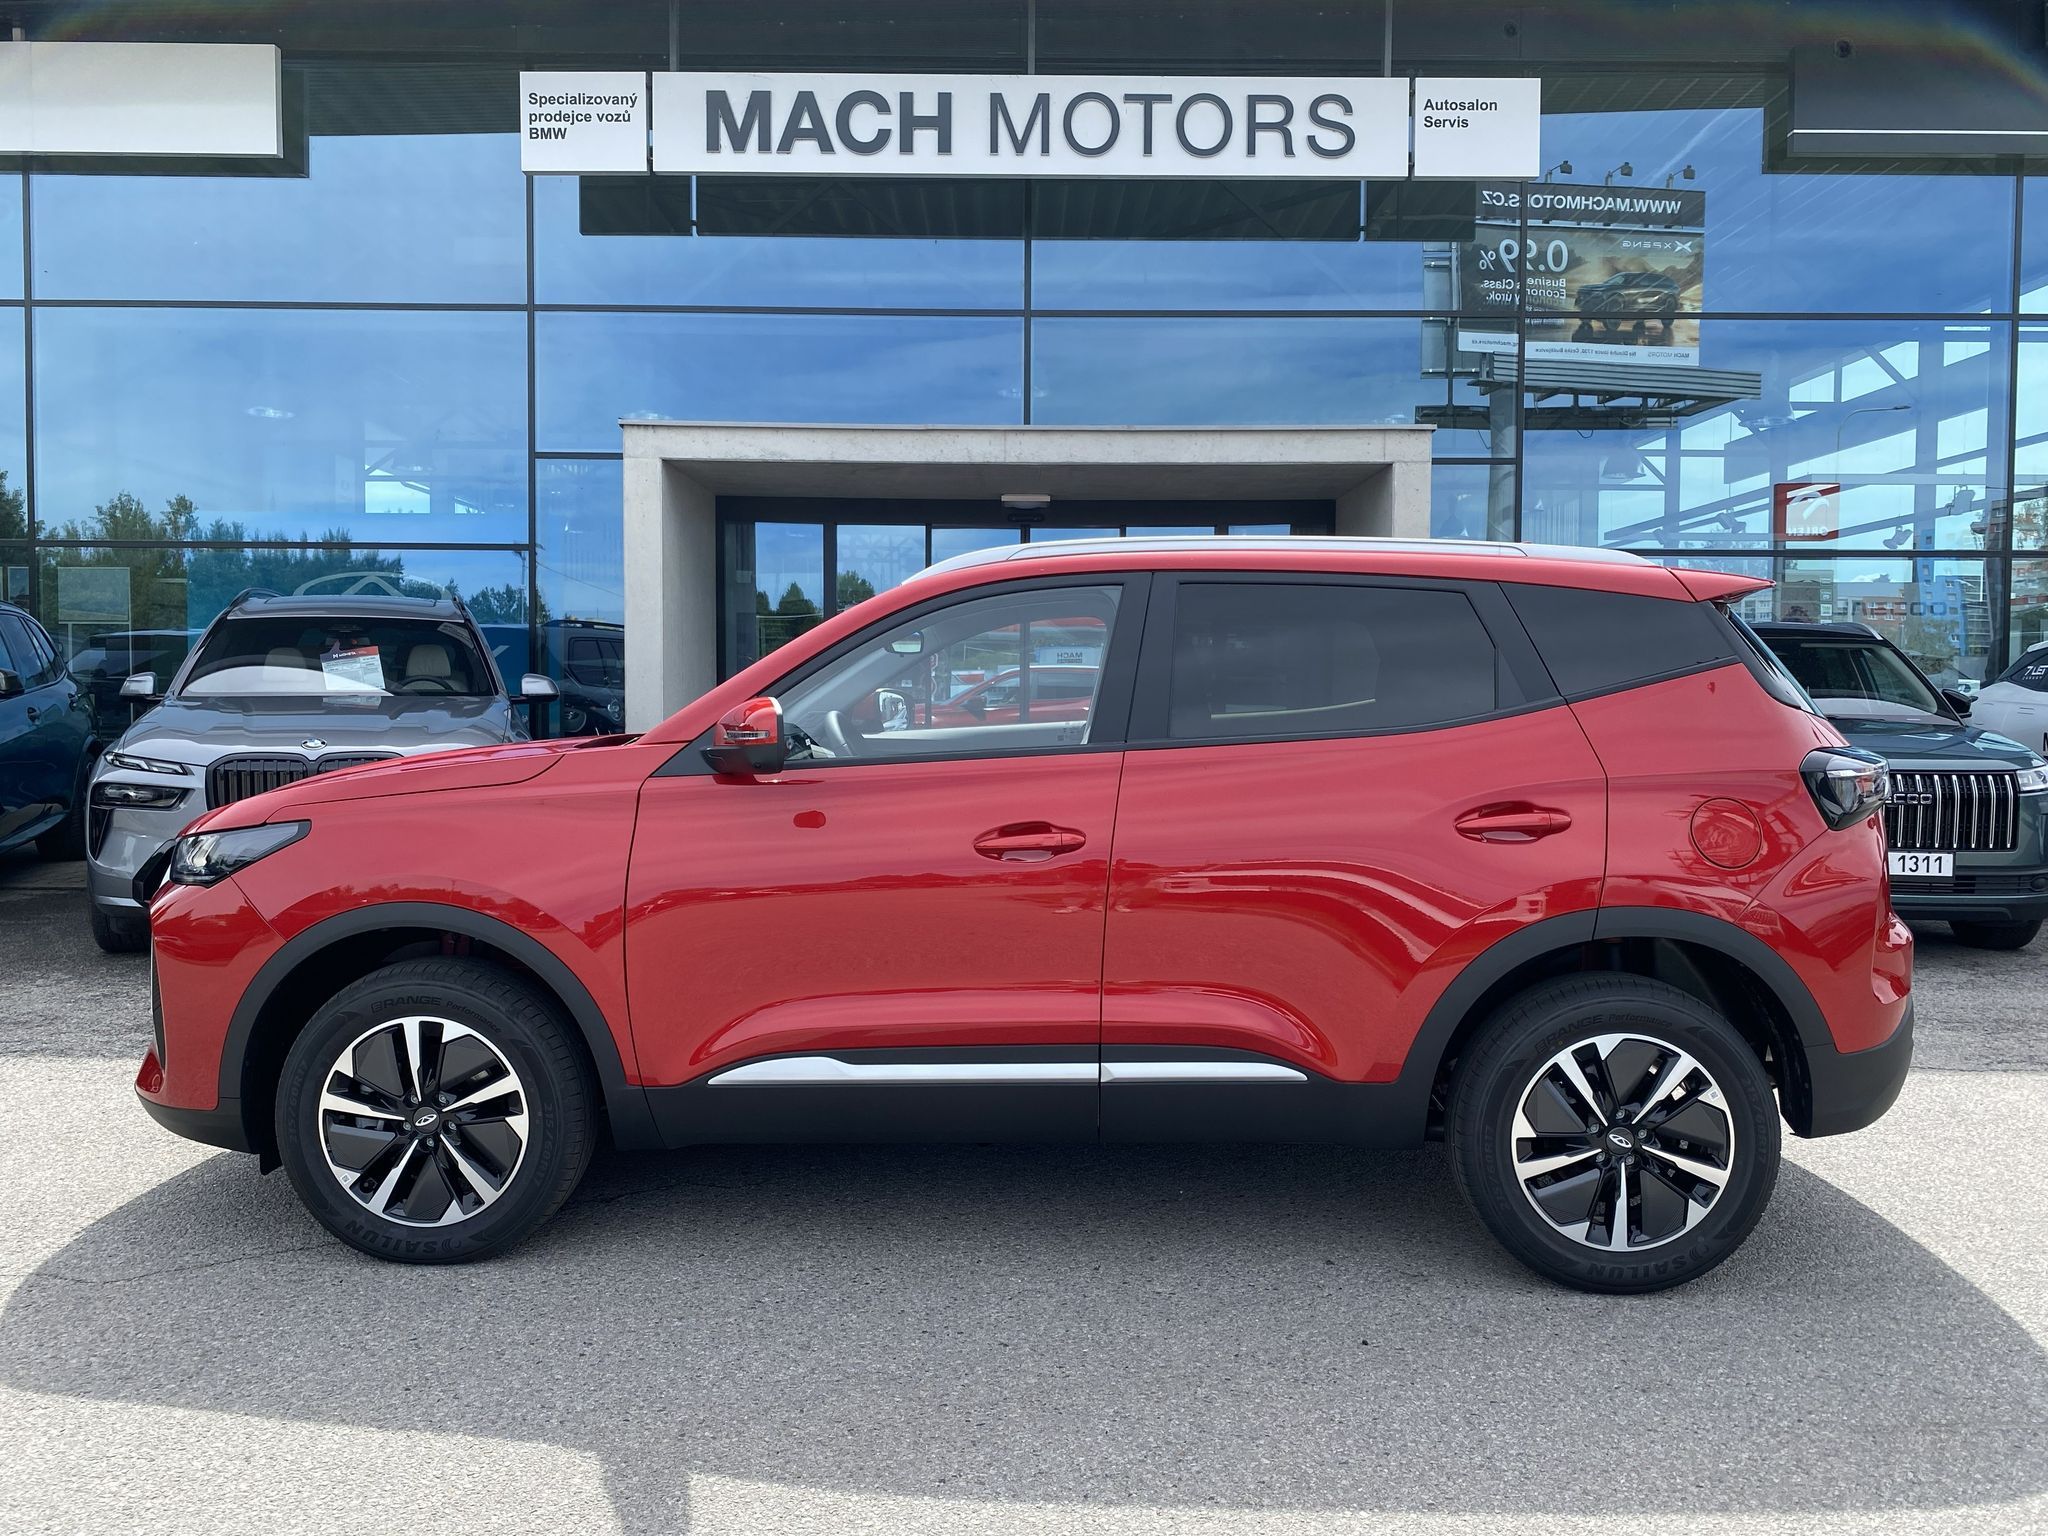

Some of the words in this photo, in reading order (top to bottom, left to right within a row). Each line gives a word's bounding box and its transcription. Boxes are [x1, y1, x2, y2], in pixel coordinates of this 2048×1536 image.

[528, 92, 638, 108] Specializovaný
[1423, 98, 1498, 112] Autosalon
[528, 110, 593, 126] prodejce
[596, 109, 632, 124] vozů
[705, 89, 953, 155] MACH
[988, 91, 1356, 159] MOTORS
[1423, 115, 1470, 129] Servis
[528, 127, 567, 140] BMW
[1898, 855, 1943, 874] 1311
[344, 1219, 438, 1254] SAILUN
[1586, 1255, 1688, 1281] SAILUN
